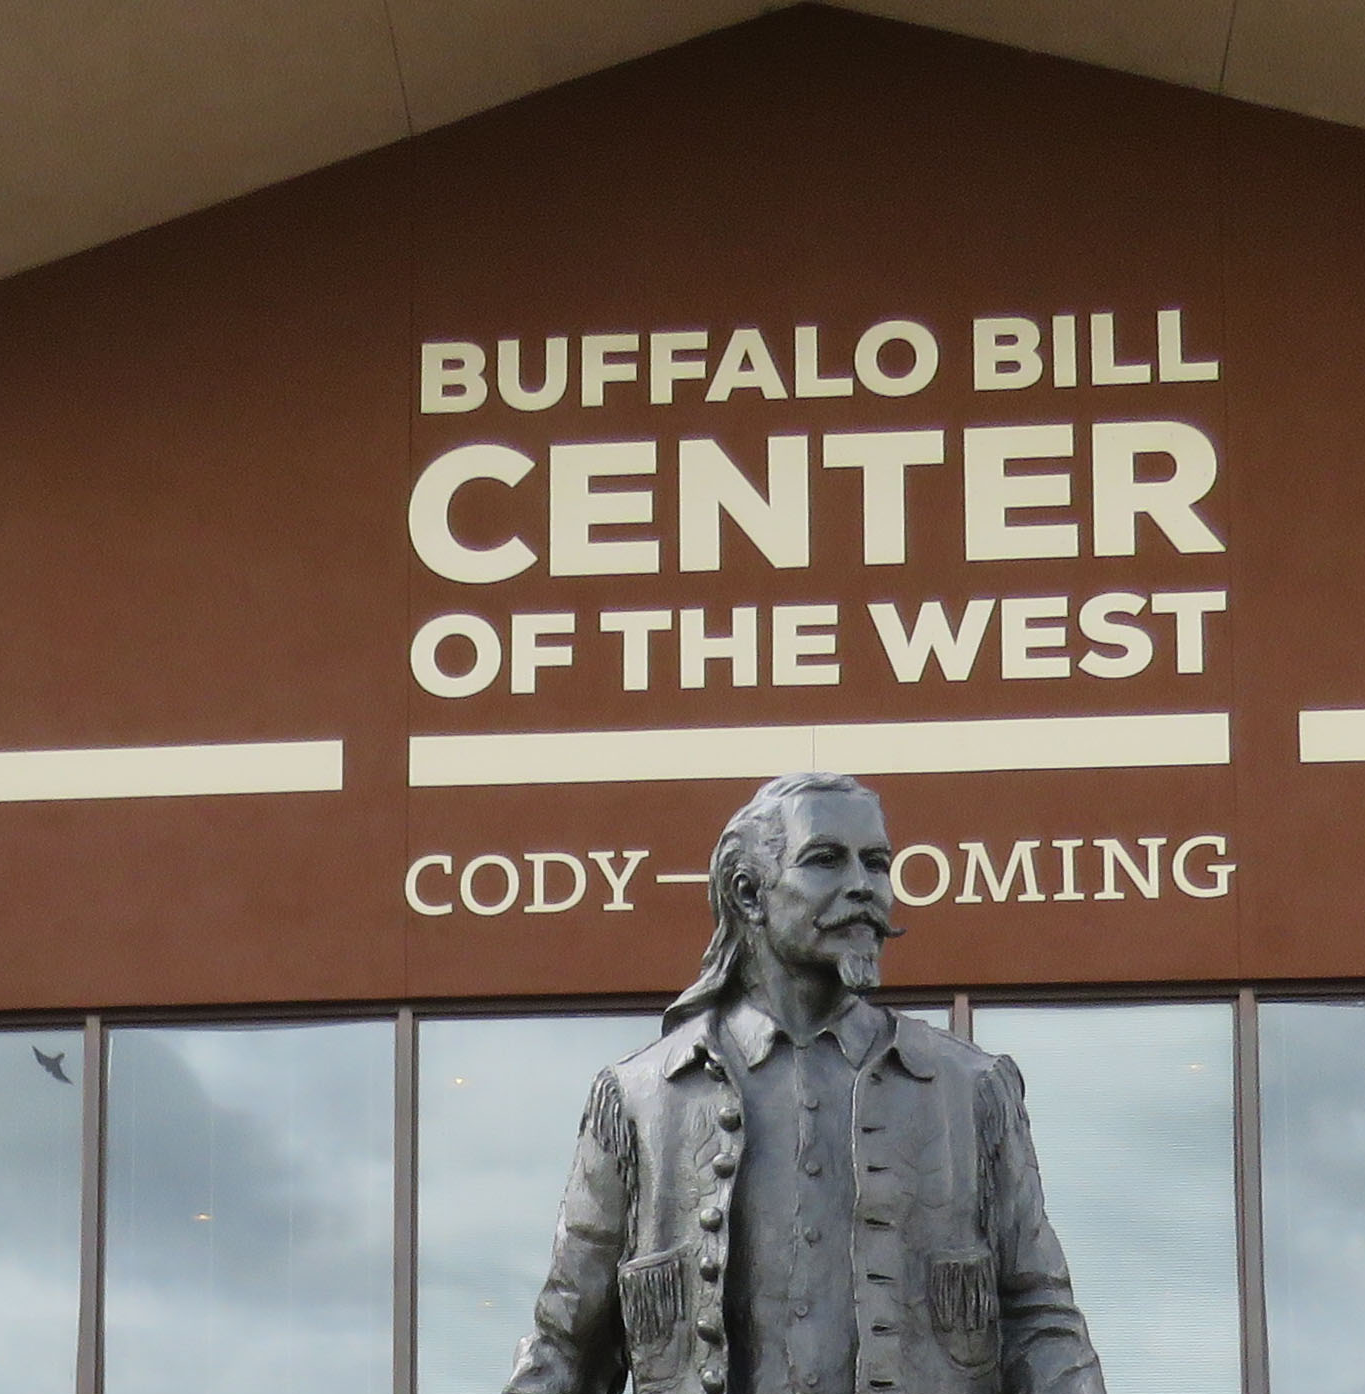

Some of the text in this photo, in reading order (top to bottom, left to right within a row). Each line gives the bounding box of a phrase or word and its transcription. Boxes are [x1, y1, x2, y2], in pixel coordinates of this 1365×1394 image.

[420, 309, 1220, 414] BUFFALO BILL
[408, 420, 1227, 584] CENTER
[410, 590, 1228, 698] OF THE WEST
[404, 849, 650, 916] CODY
[889, 835, 1237, 907] OMING
